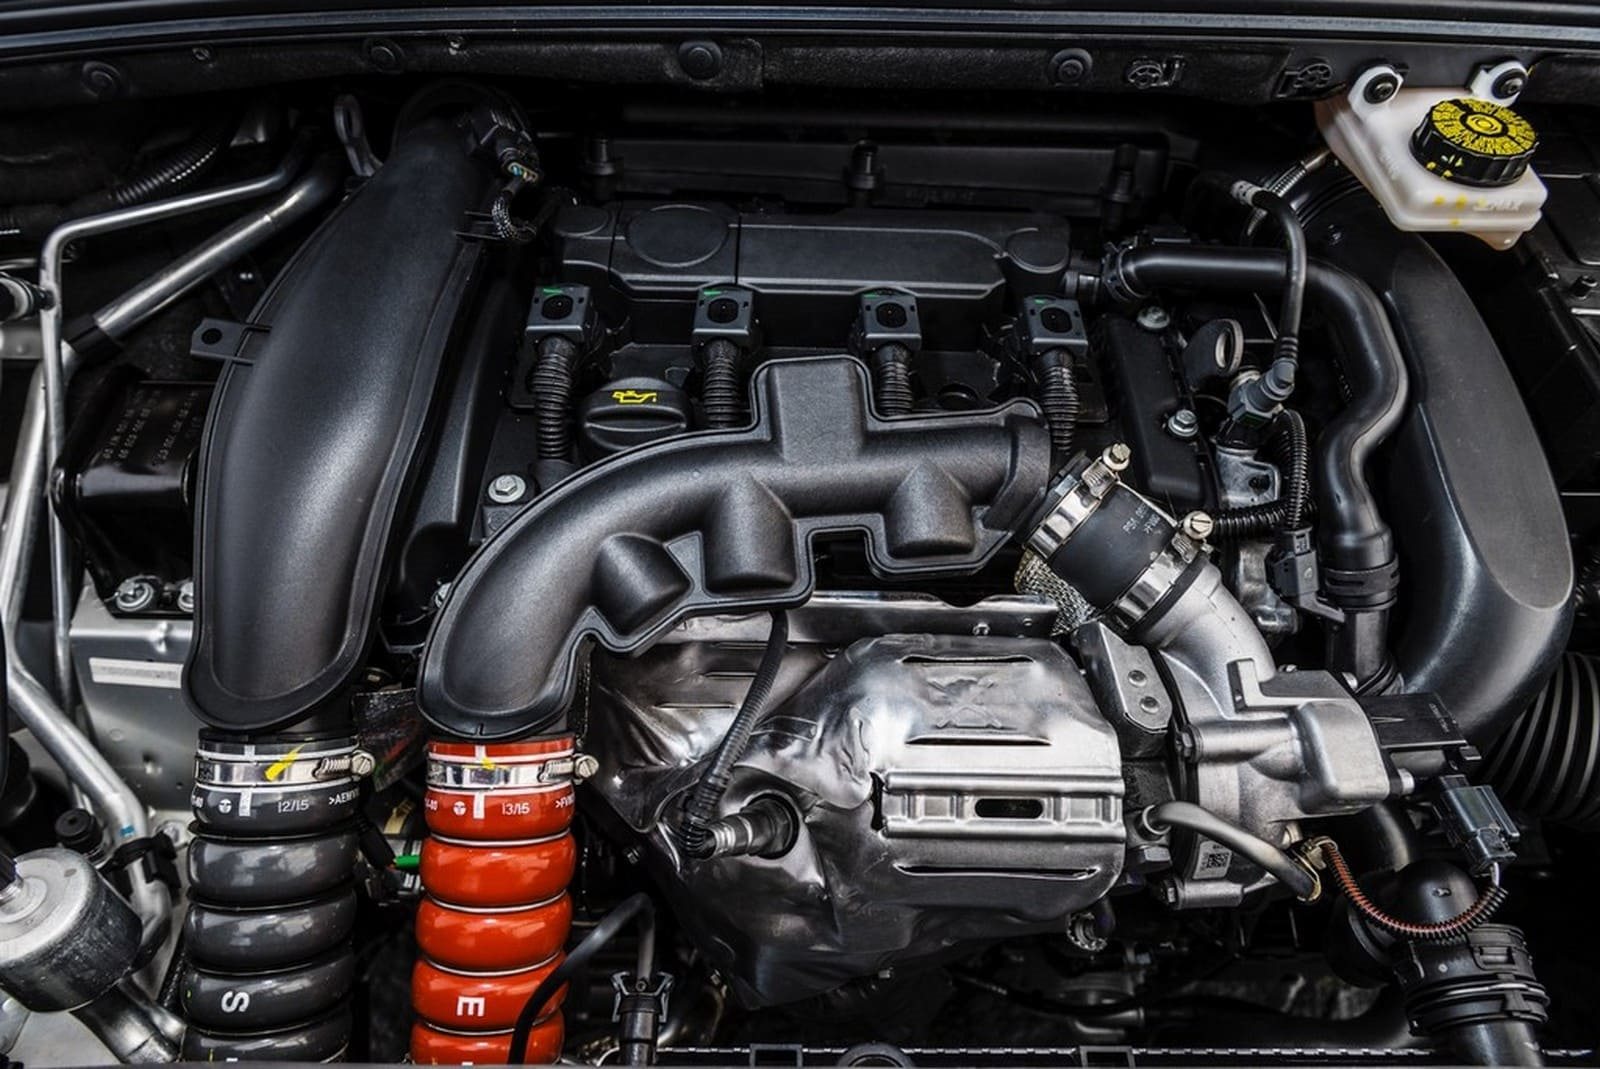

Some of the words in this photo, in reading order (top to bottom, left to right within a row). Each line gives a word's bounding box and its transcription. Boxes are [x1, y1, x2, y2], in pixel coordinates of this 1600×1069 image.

[278, 799, 310, 814] 12/15
[501, 802, 530, 816] 13/15
[221, 990, 250, 1013] S
[456, 995, 486, 1017] E
